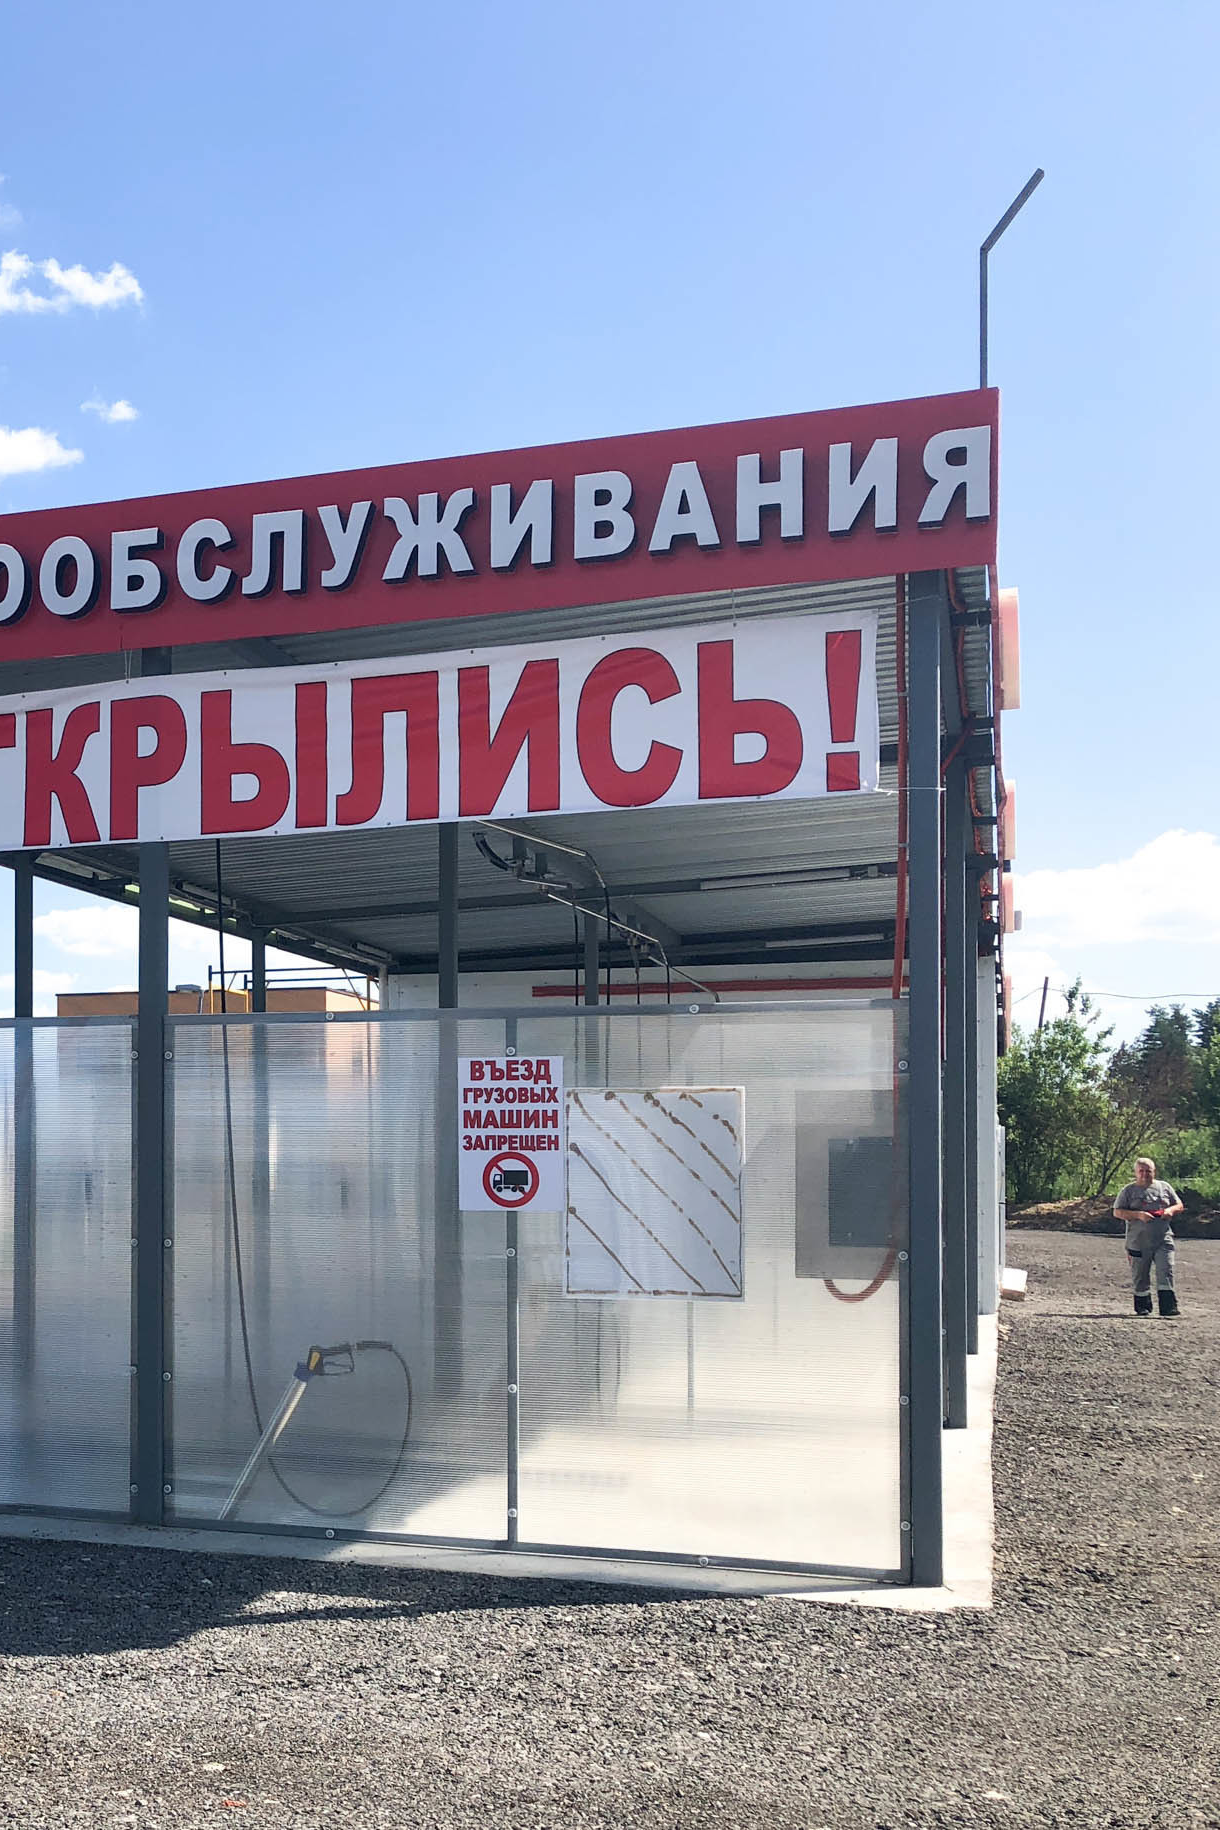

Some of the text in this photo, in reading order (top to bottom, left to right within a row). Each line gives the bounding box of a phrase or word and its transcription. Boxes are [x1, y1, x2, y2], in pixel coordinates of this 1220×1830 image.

[469, 1059, 552, 1084] ВЪЕЗД
[462, 1086, 559, 1104] ГРУЗОВЫХ
[462, 1109, 559, 1129] МАШИН
[462, 1134, 560, 1152] ЗАПРЕЩЕН
